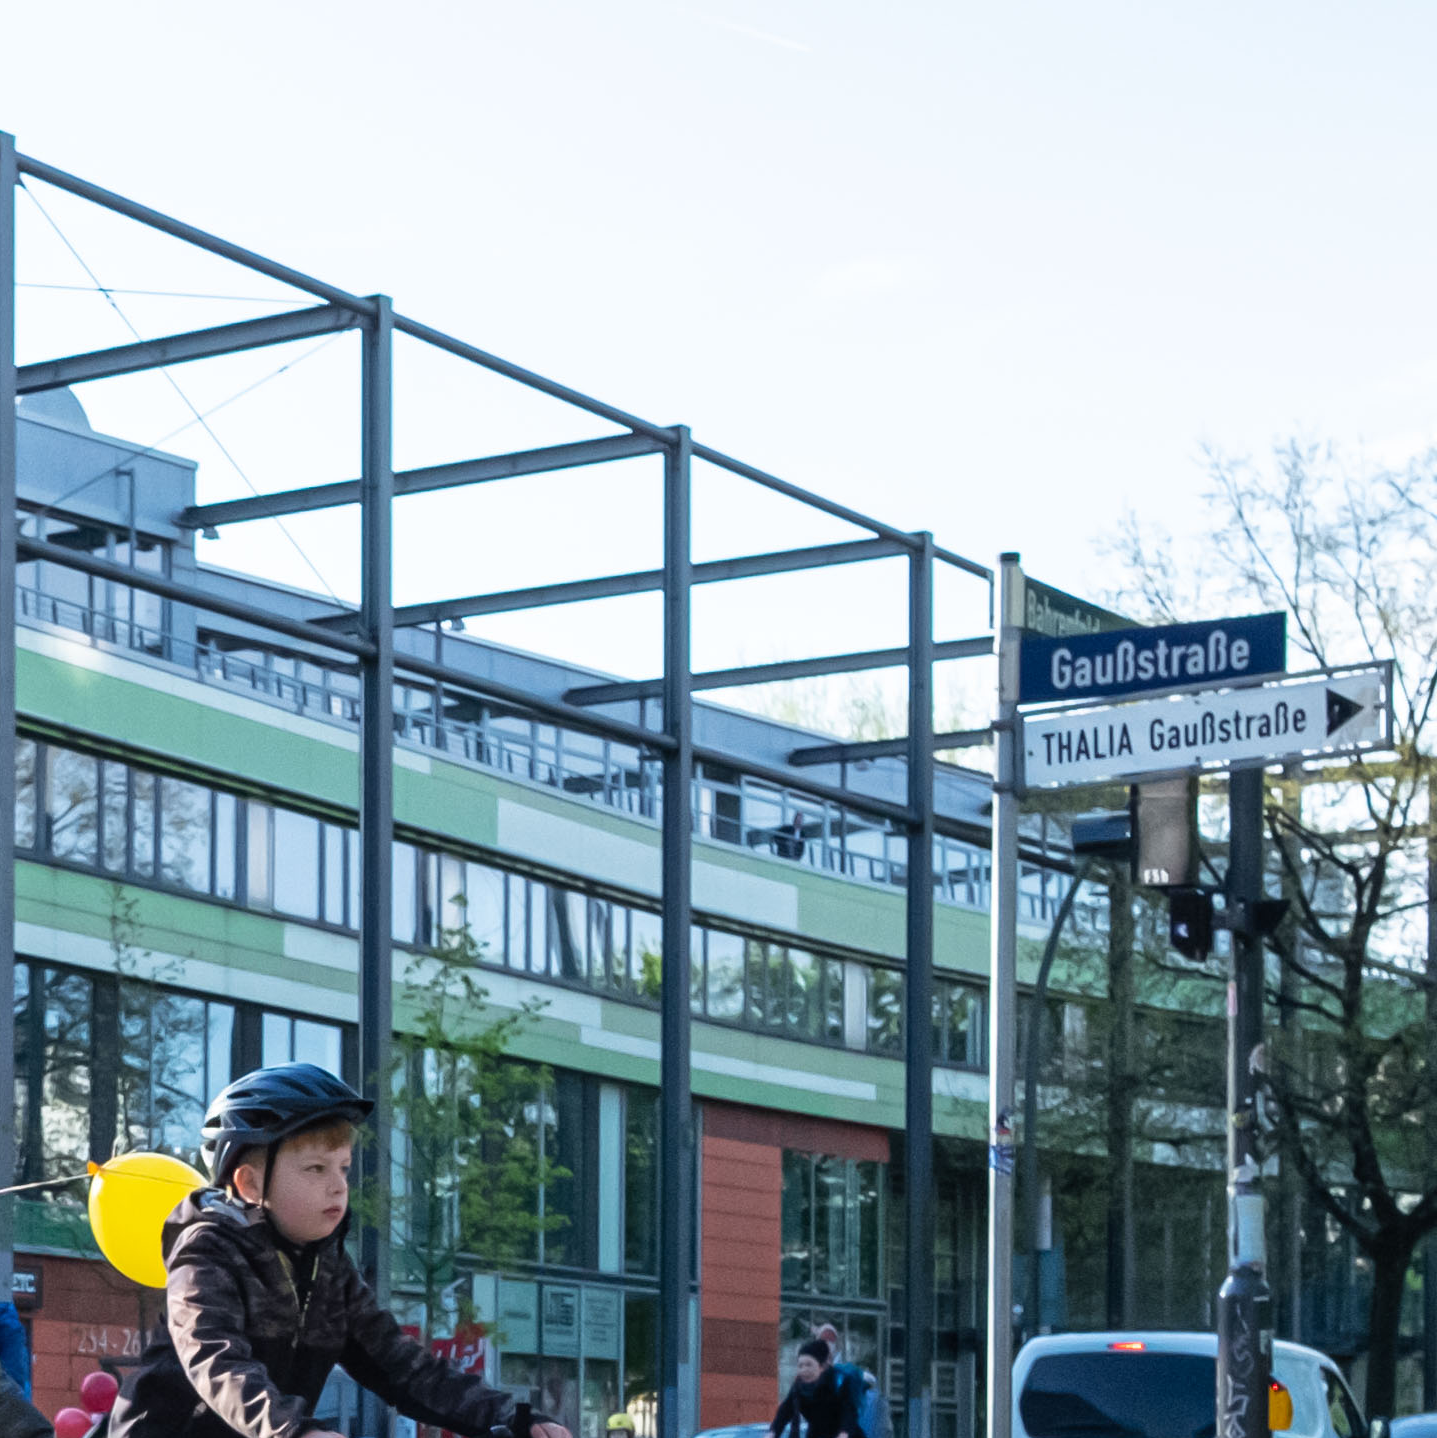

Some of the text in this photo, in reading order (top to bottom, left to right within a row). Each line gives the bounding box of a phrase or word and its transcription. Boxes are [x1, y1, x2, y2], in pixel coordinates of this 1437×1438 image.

[1051, 629, 1250, 690] Gaußstraße
[1042, 701, 1307, 766] THALIA Gaußstraße
